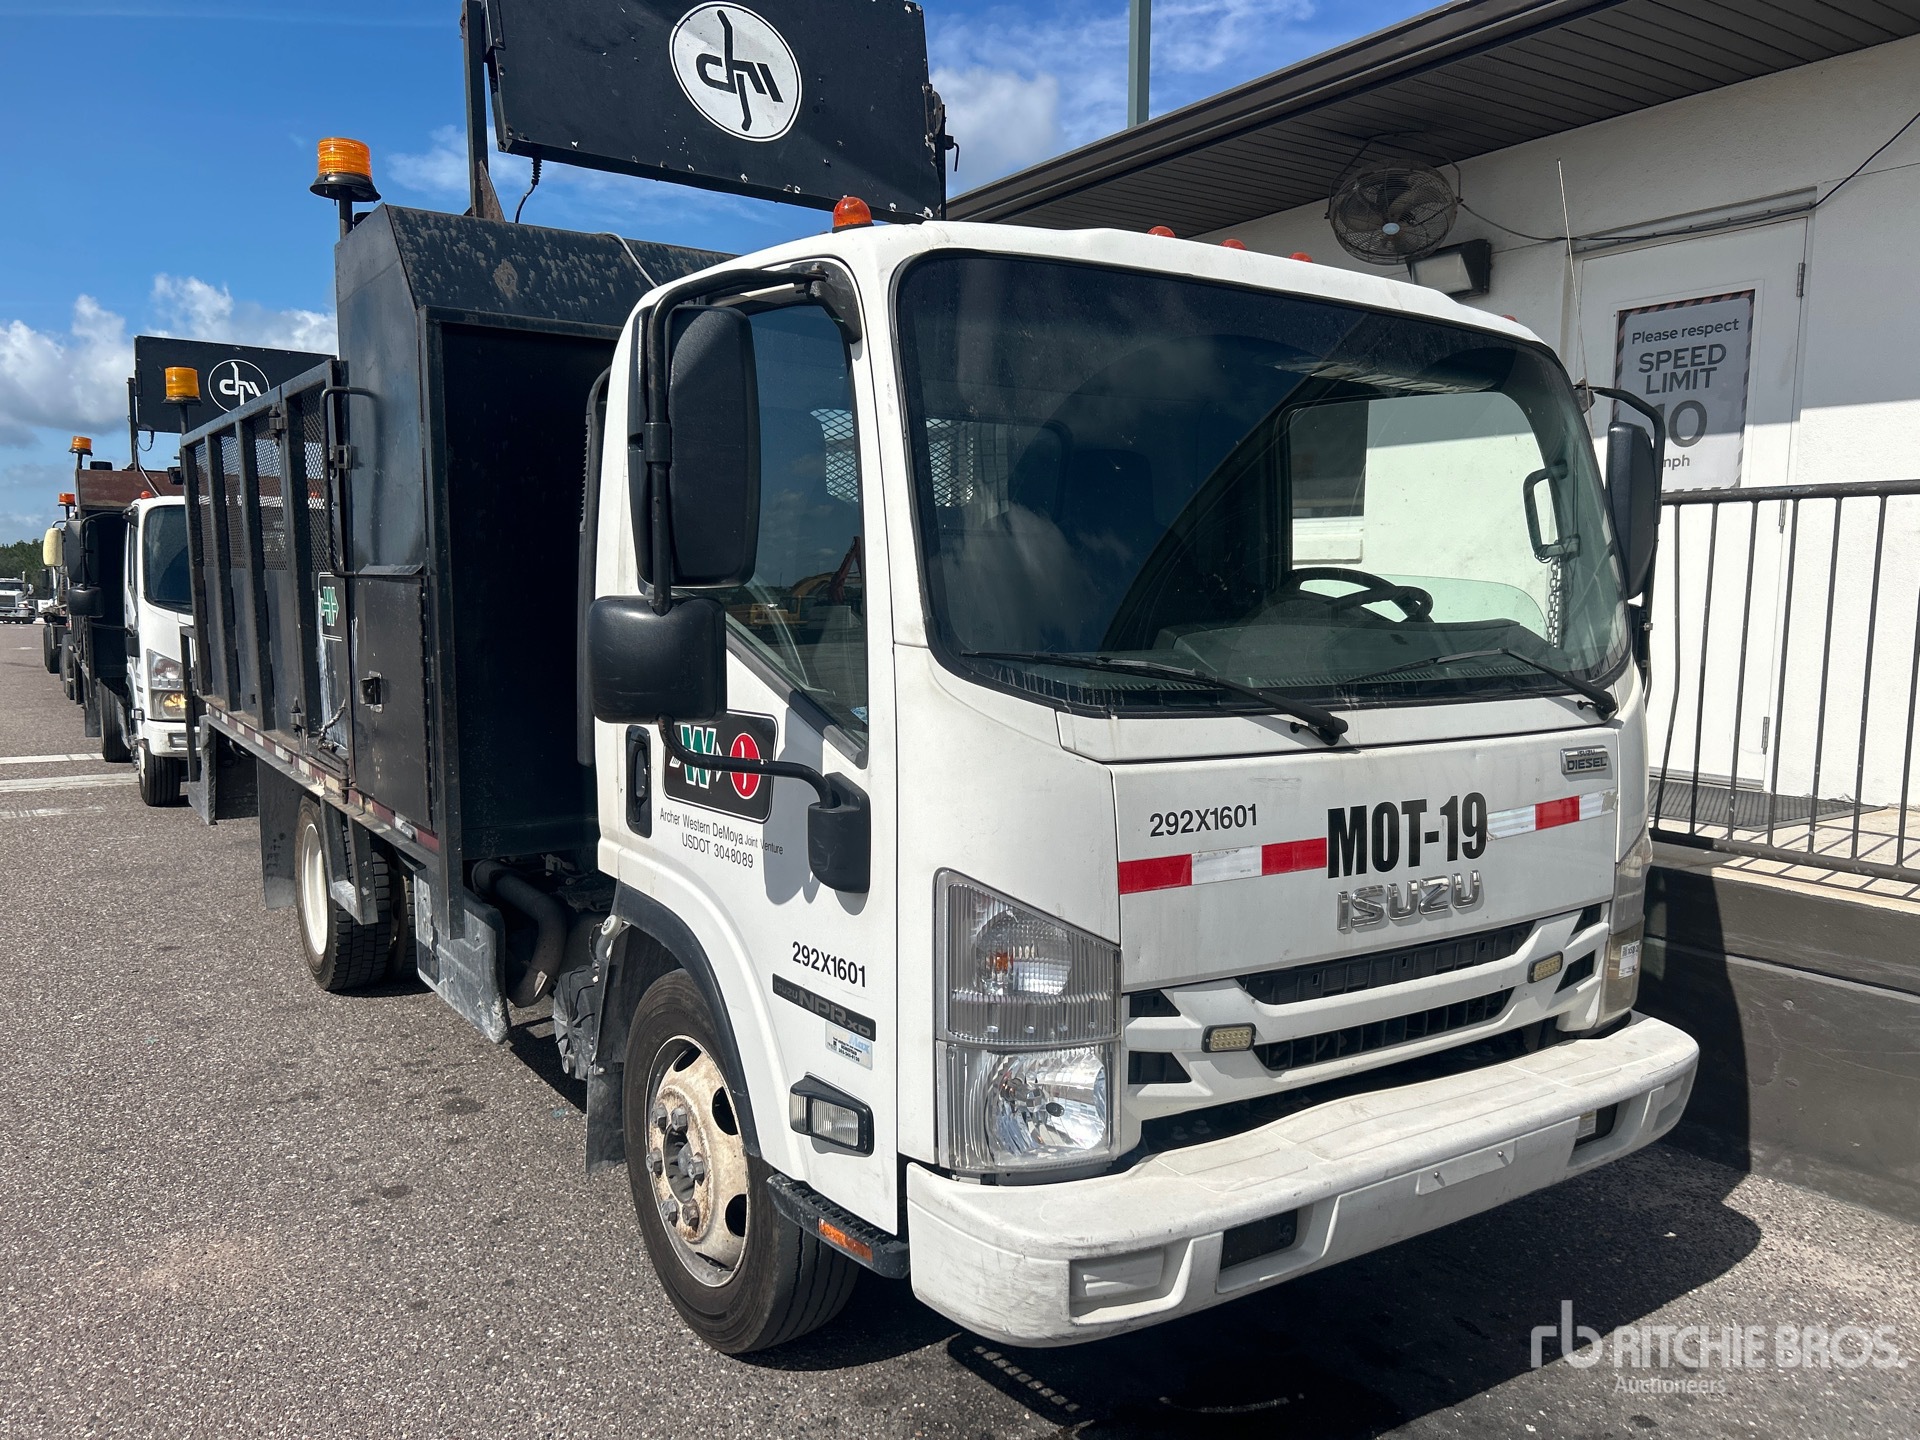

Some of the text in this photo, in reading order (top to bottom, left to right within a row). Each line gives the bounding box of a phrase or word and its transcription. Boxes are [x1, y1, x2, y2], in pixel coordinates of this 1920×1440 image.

[1631, 318, 1740, 345] Please respect
[1638, 343, 1727, 374] SPEED
[1645, 366, 1718, 395] LIMIT
[1567, 757, 1607, 771] DIESEL
[659, 807, 784, 855] Archer Western DeMoya Joint Venture
[1149, 803, 1257, 838] 292X1601
[1327, 791, 1488, 880] MOT-19
[681, 832, 755, 869] USDOT 3048089
[1336, 869, 1483, 931] ISUZU
[791, 941, 866, 988] 292X1601
[774, 980, 798, 1000] ISUZU
